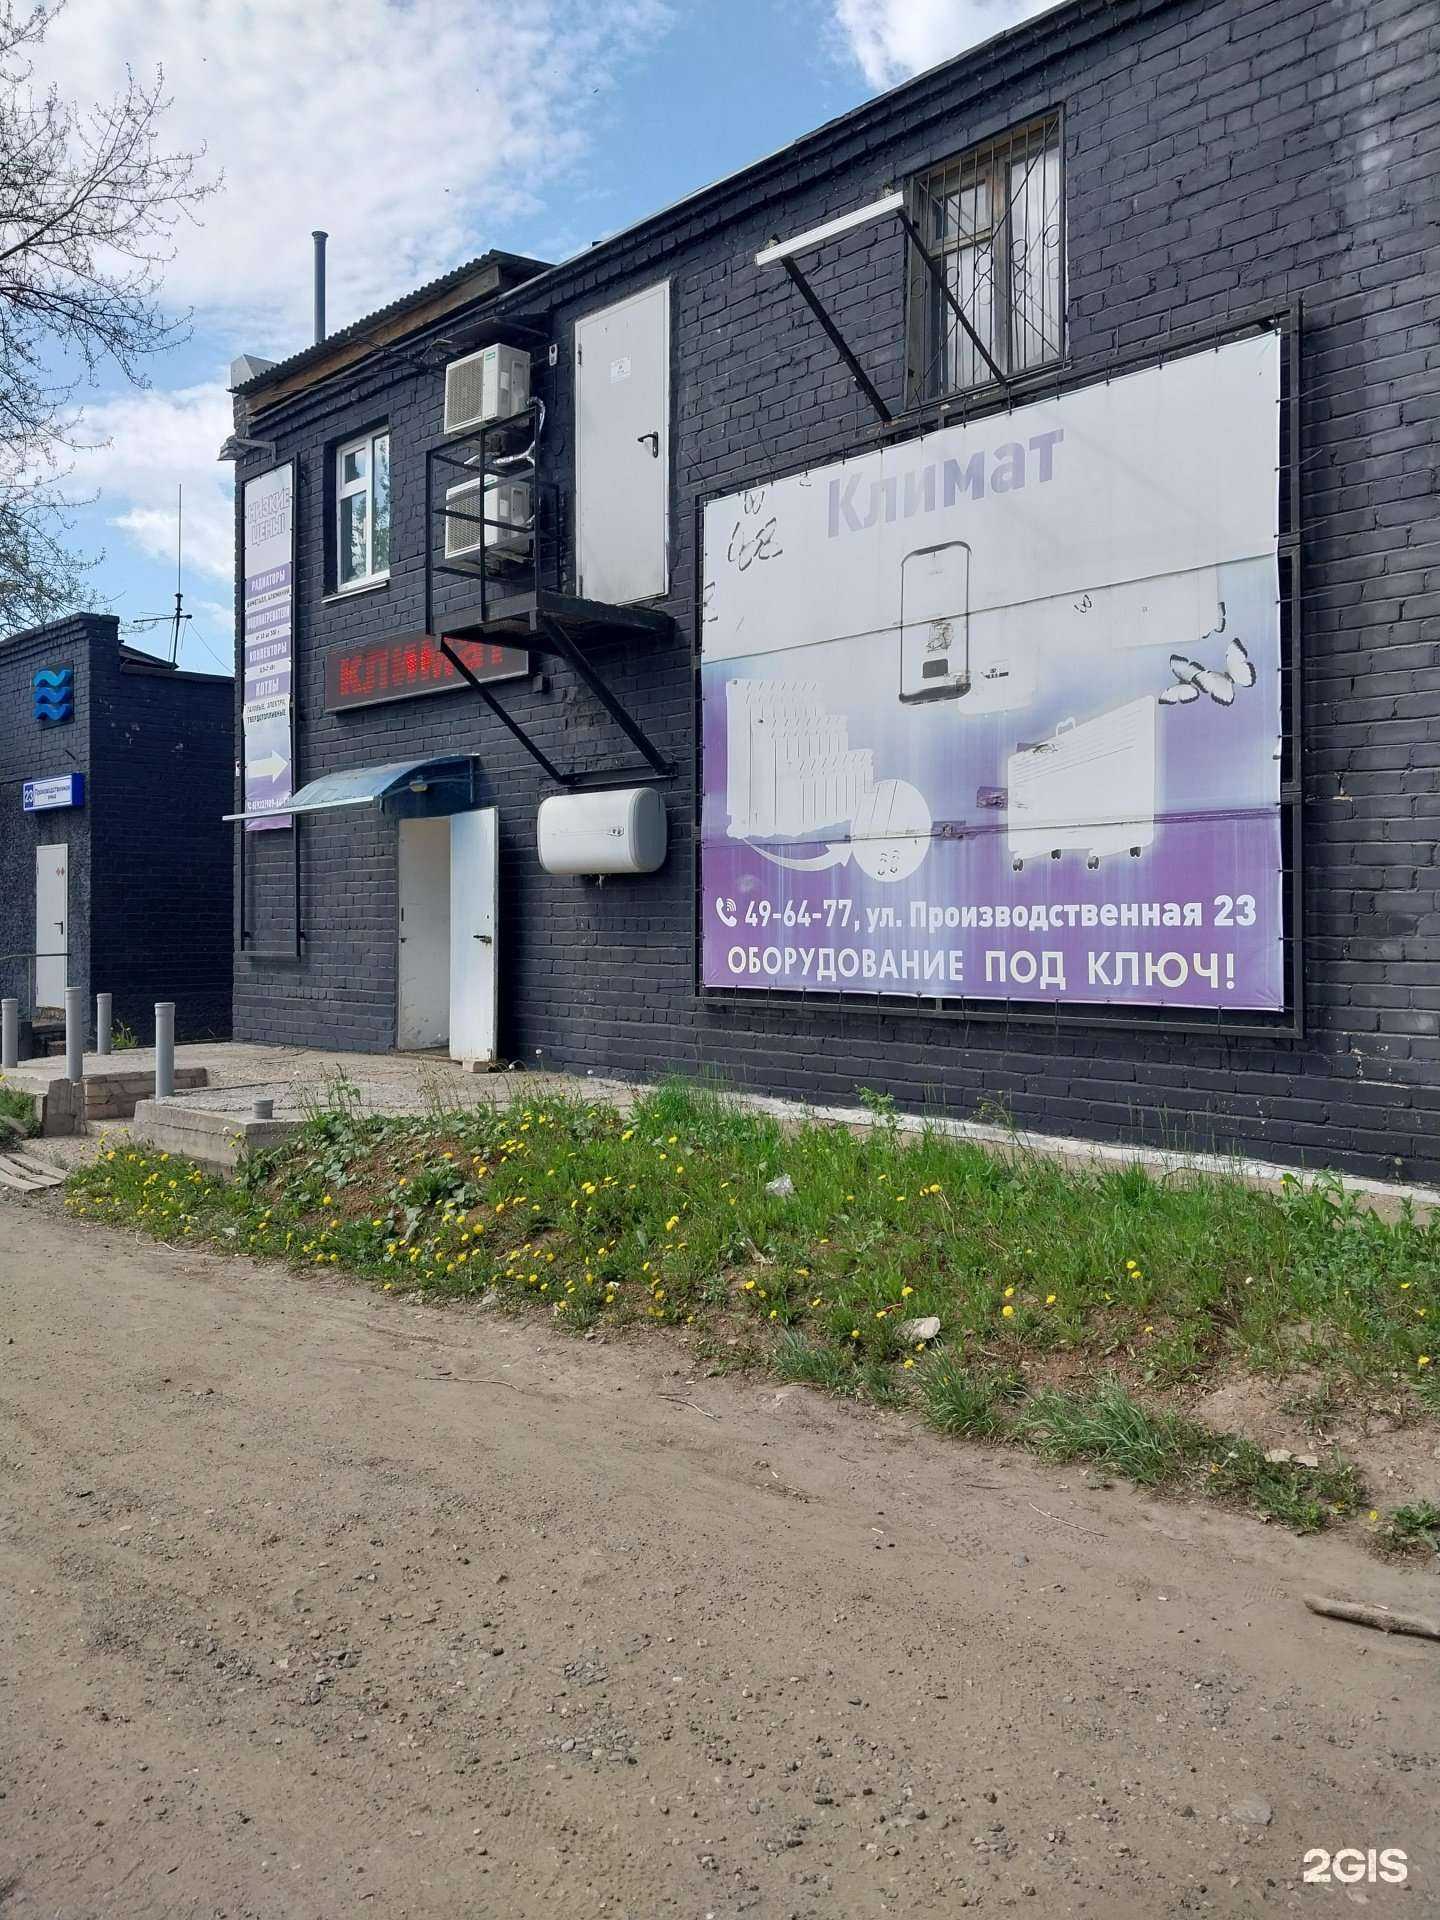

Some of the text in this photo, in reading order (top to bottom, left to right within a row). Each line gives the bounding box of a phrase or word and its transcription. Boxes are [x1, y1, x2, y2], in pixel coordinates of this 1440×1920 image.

[827, 428, 1064, 538] Климат
[247, 487, 290, 524] НИЗКИЕ
[251, 513, 286, 546] ЦЕНЫ
[251, 570, 285, 592] РАДИАТОРЫ
[249, 641, 287, 663] КОНВЕКТОРЫ
[255, 677, 279, 697] КОТЛЫ
[744, 894, 1256, 934] 49-64-77, ул. Производственная 23
[727, 946, 1234, 990] ОБОРУДОВАНИЕ ПОД КЛЮЧ!
